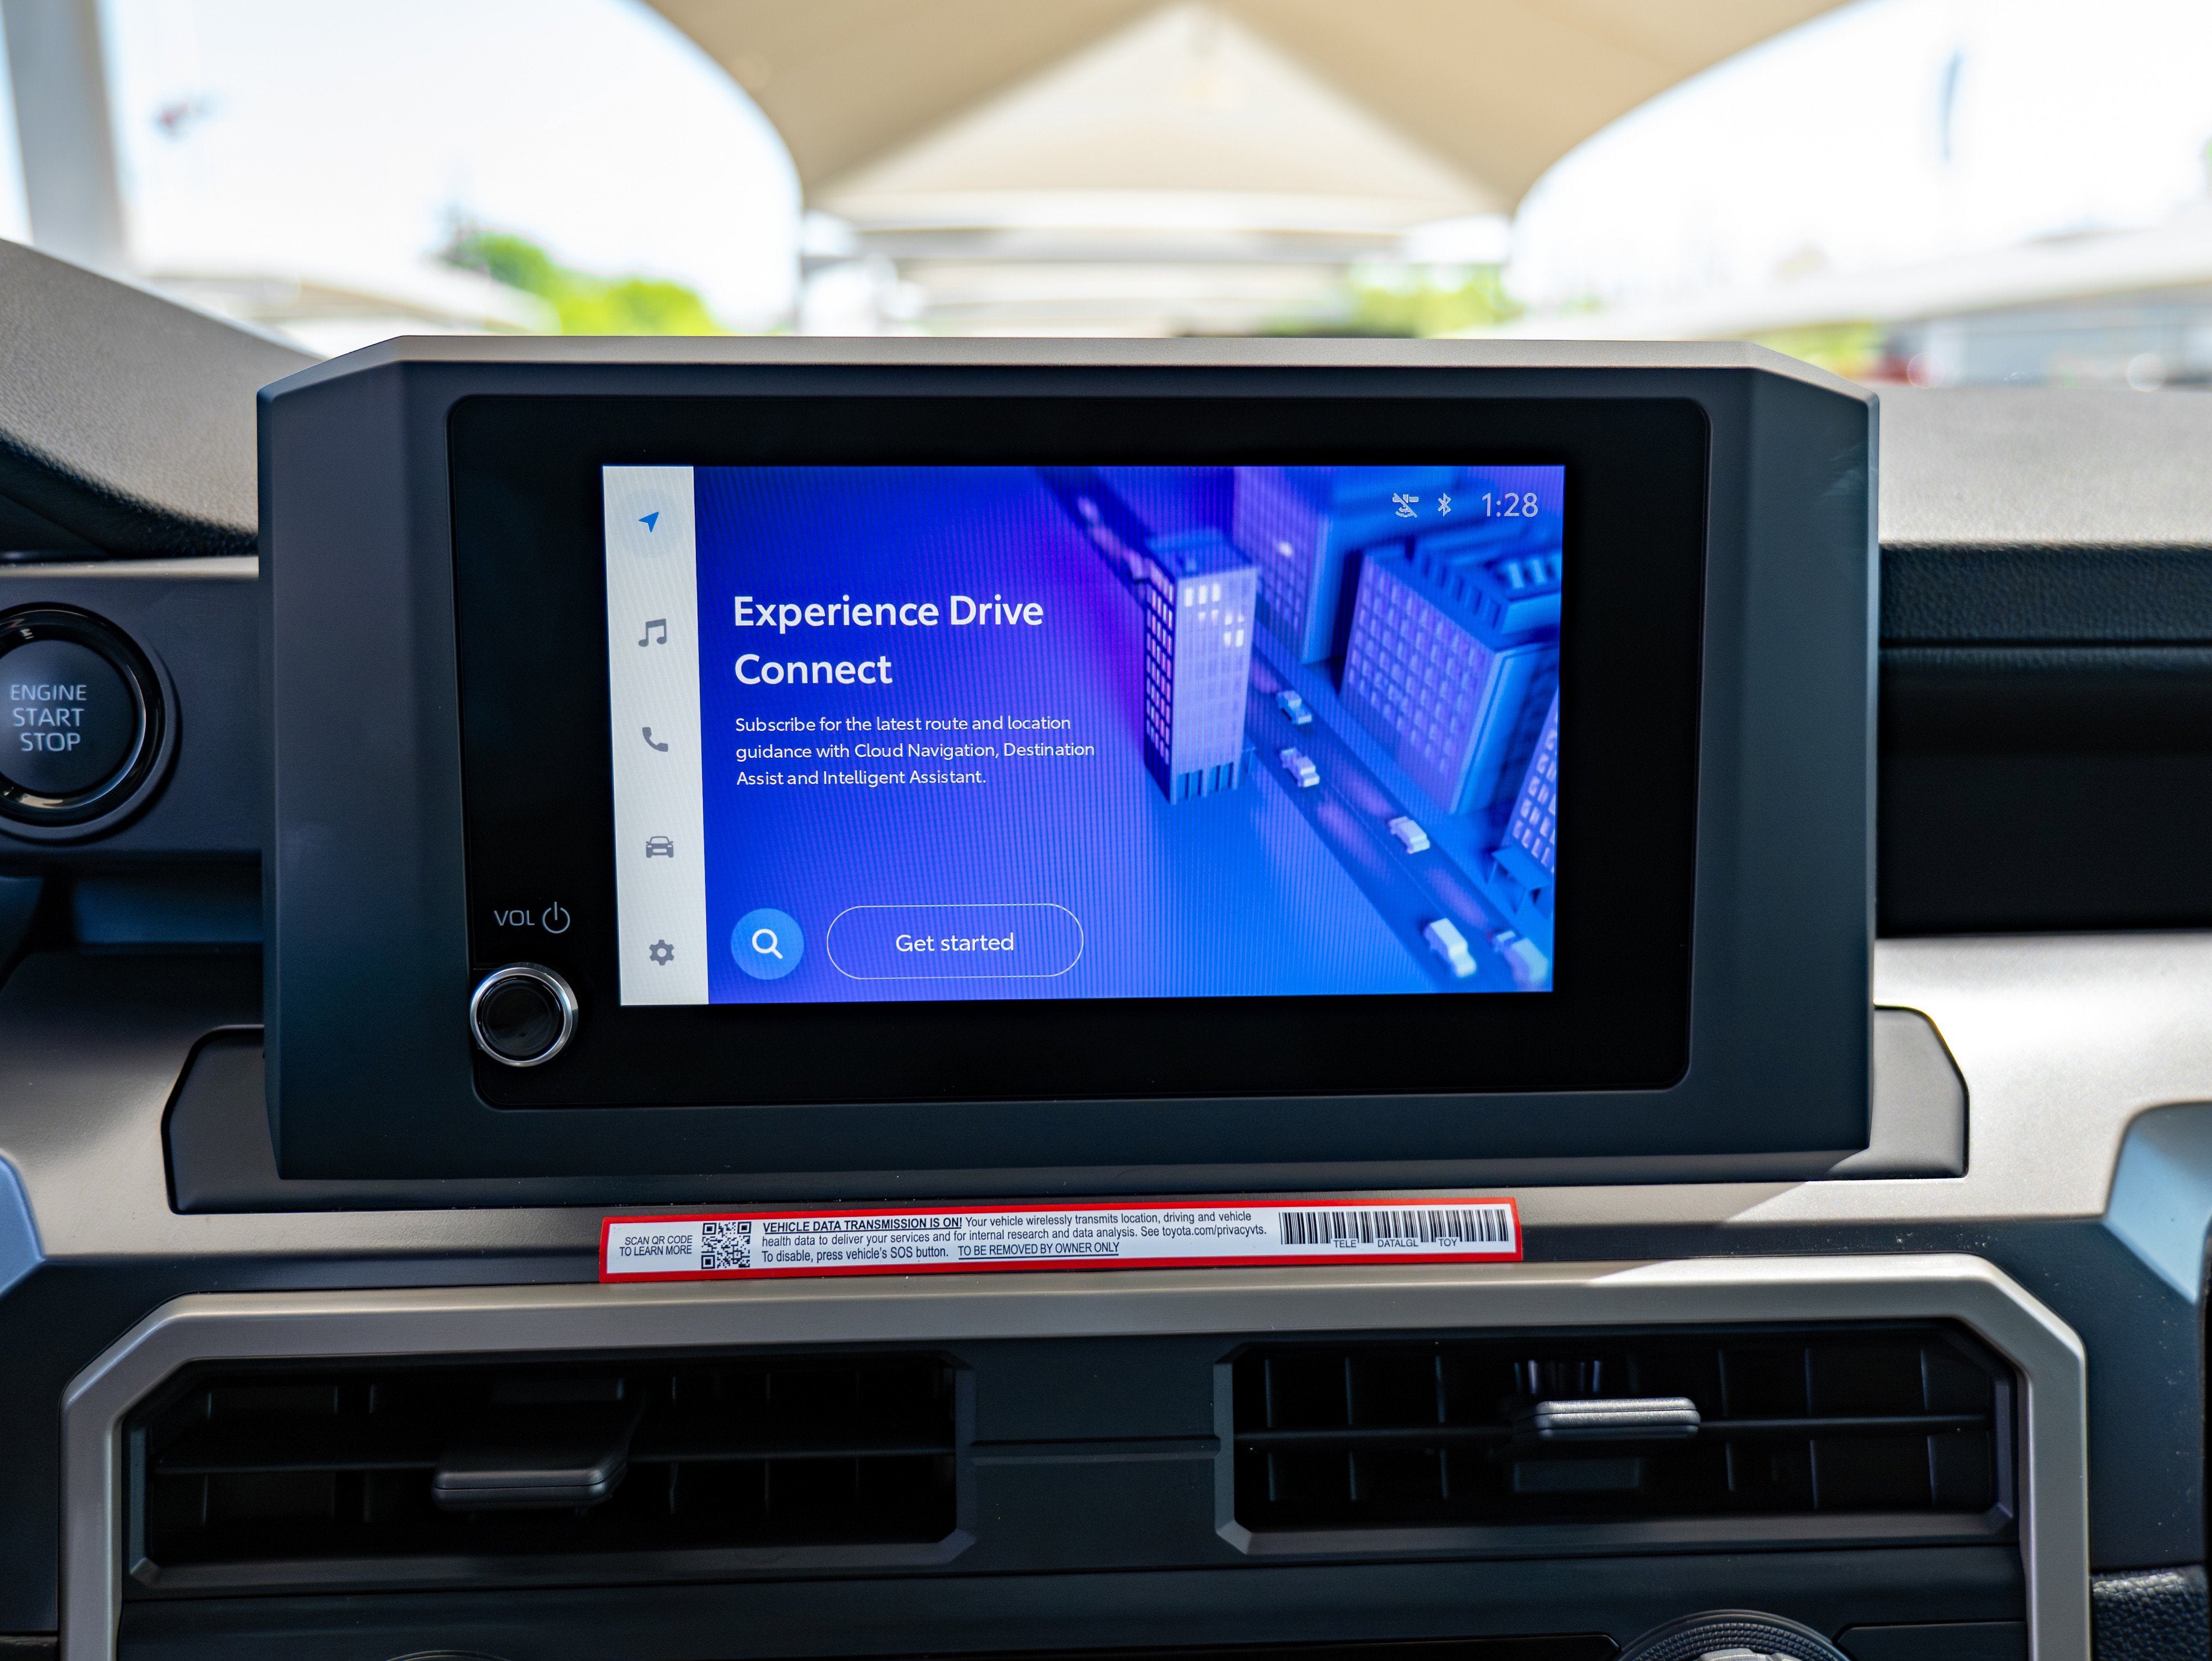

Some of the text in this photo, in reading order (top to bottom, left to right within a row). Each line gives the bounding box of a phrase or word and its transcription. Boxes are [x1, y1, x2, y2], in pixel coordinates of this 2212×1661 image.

[1482, 493, 1538, 517] 1:28
[735, 594, 1043, 634] Experience Drive
[735, 654, 893, 684] Connect
[11, 685, 87, 701] ENGINE
[13, 709, 84, 727] START
[736, 716, 1070, 732] Subscribe for the latest route and location
[20, 733, 80, 751] STOP
[736, 743, 1094, 762] guidance with Cloud Navigation, Destination
[737, 770, 986, 788] Assist and Intelligent Assistant.
[494, 911, 535, 928] VOL
[896, 932, 1014, 953] Get started
[763, 1211, 1251, 1232] VEHICLE DATA TRANSMISSION IS ON! Your vehicle wirelessly transmits location, driving and vehicle
[625, 1235, 692, 1245] SCAN QR CODE
[762, 1224, 1266, 1246] health data to deliver your services and for internal research and data analysis. See toyota.com/privacyvts.
[1334, 1238, 1457, 1247] TELE DATALGL TOY
[620, 1246, 692, 1256] TO LEARN MORE
[762, 1247, 948, 1263] To disable, press vehicle's SOS button.
[958, 1242, 1119, 1255] TO BE REMOVED BY OWNER ONLY
